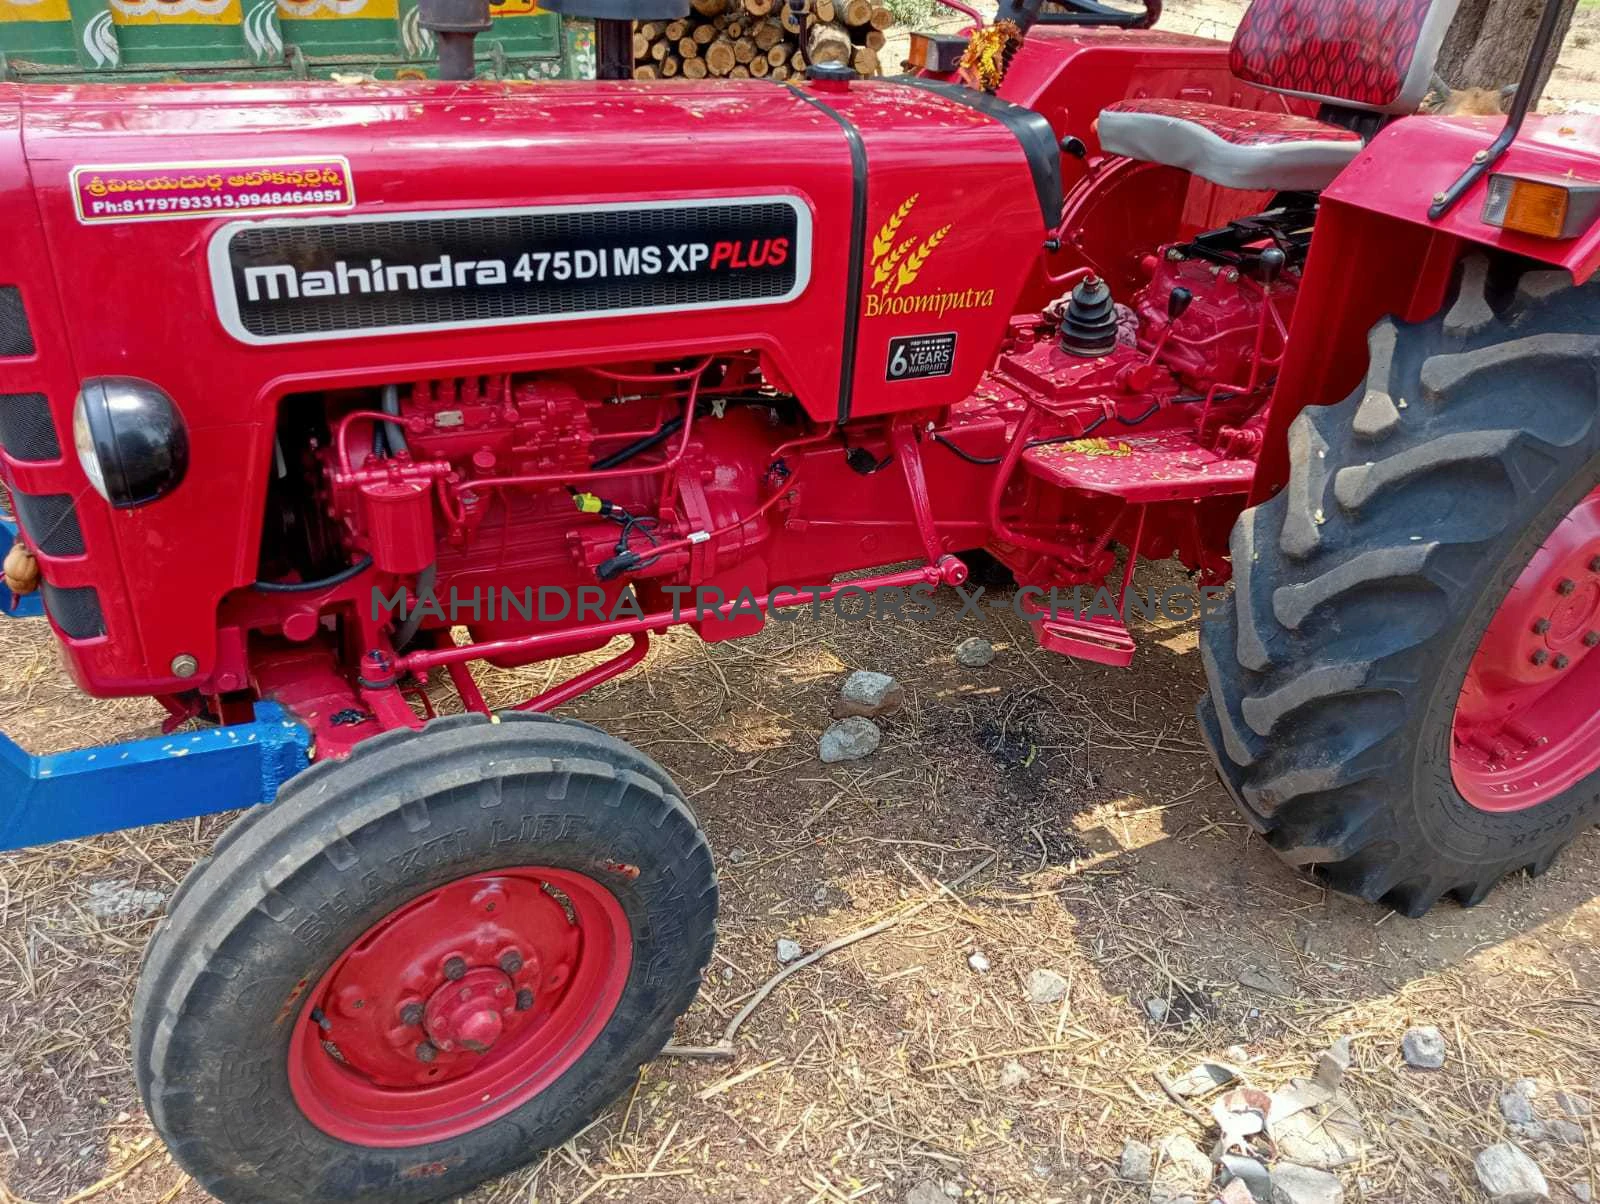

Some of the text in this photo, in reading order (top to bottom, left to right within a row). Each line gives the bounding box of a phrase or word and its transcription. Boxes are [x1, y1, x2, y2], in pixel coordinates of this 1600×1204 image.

[614, 246, 662, 276] MS
[667, 243, 709, 273] XP
[710, 238, 789, 270] PLUS
[864, 286, 995, 319] Bhoomiputra
[889, 344, 950, 377] 6 YEARS
[908, 362, 947, 373] WARRANTY
